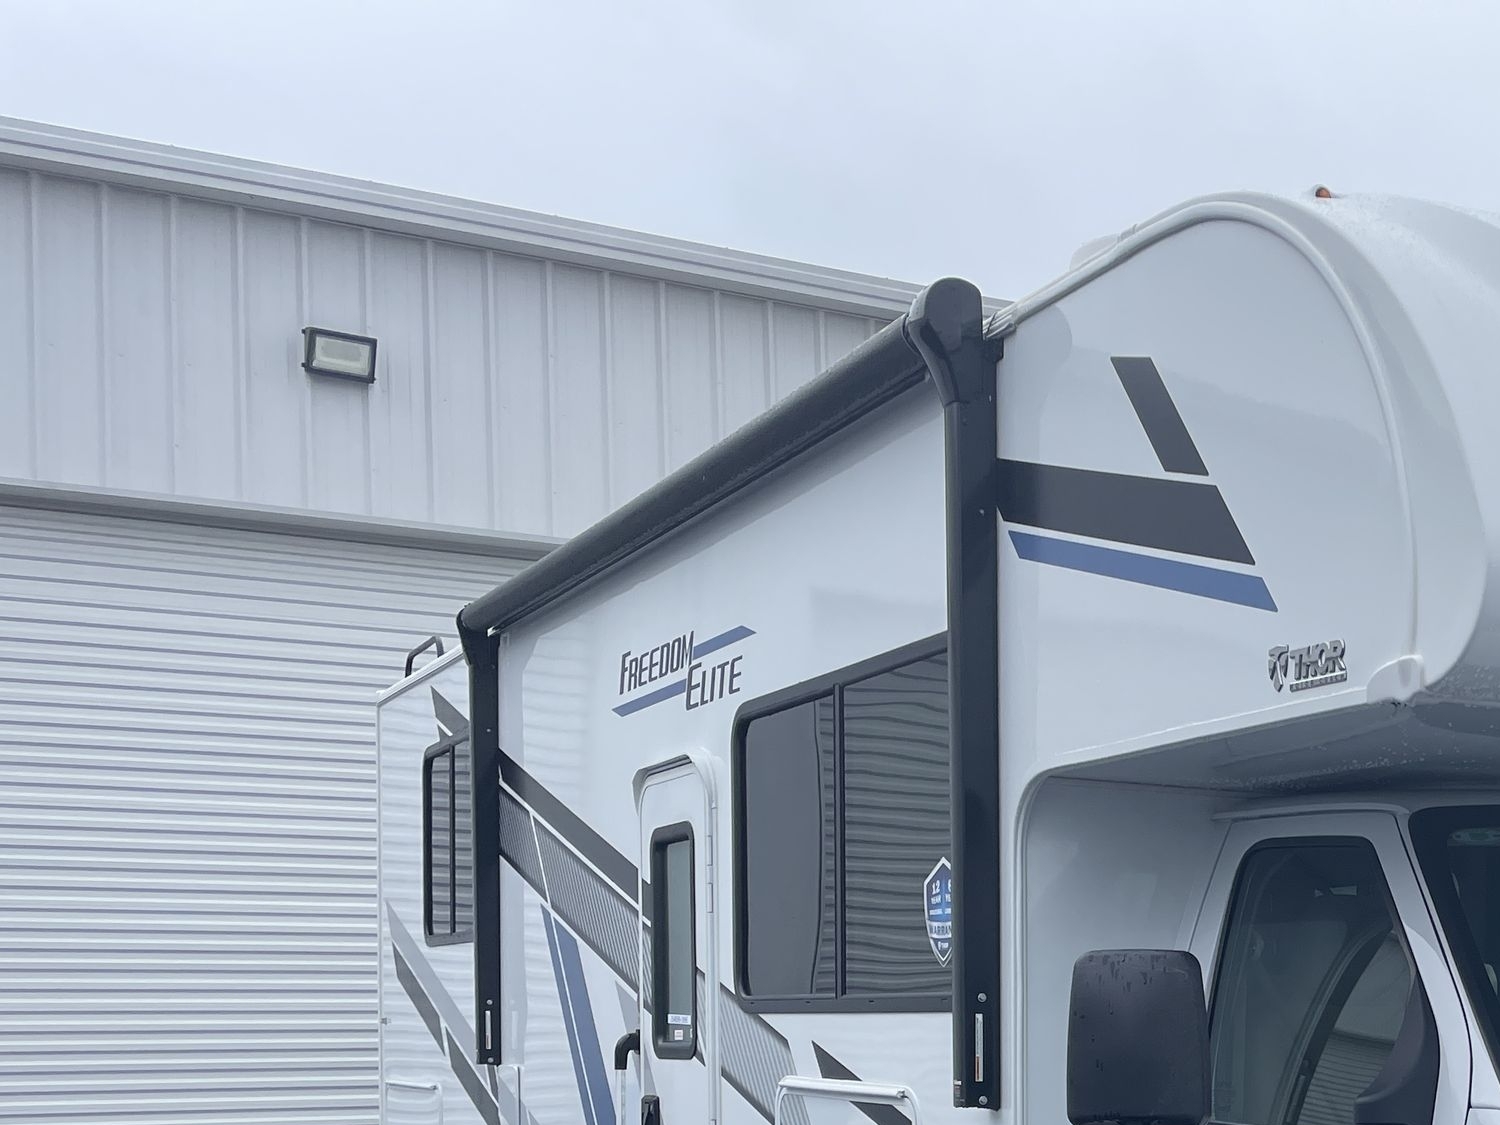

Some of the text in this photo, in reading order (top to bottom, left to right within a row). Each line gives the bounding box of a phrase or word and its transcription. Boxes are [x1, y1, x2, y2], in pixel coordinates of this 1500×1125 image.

[619, 631, 694, 695] FREEDOM
[685, 655, 743, 711] ELITE
[1290, 640, 1347, 681] THOR
[932, 880, 941, 895] 12
